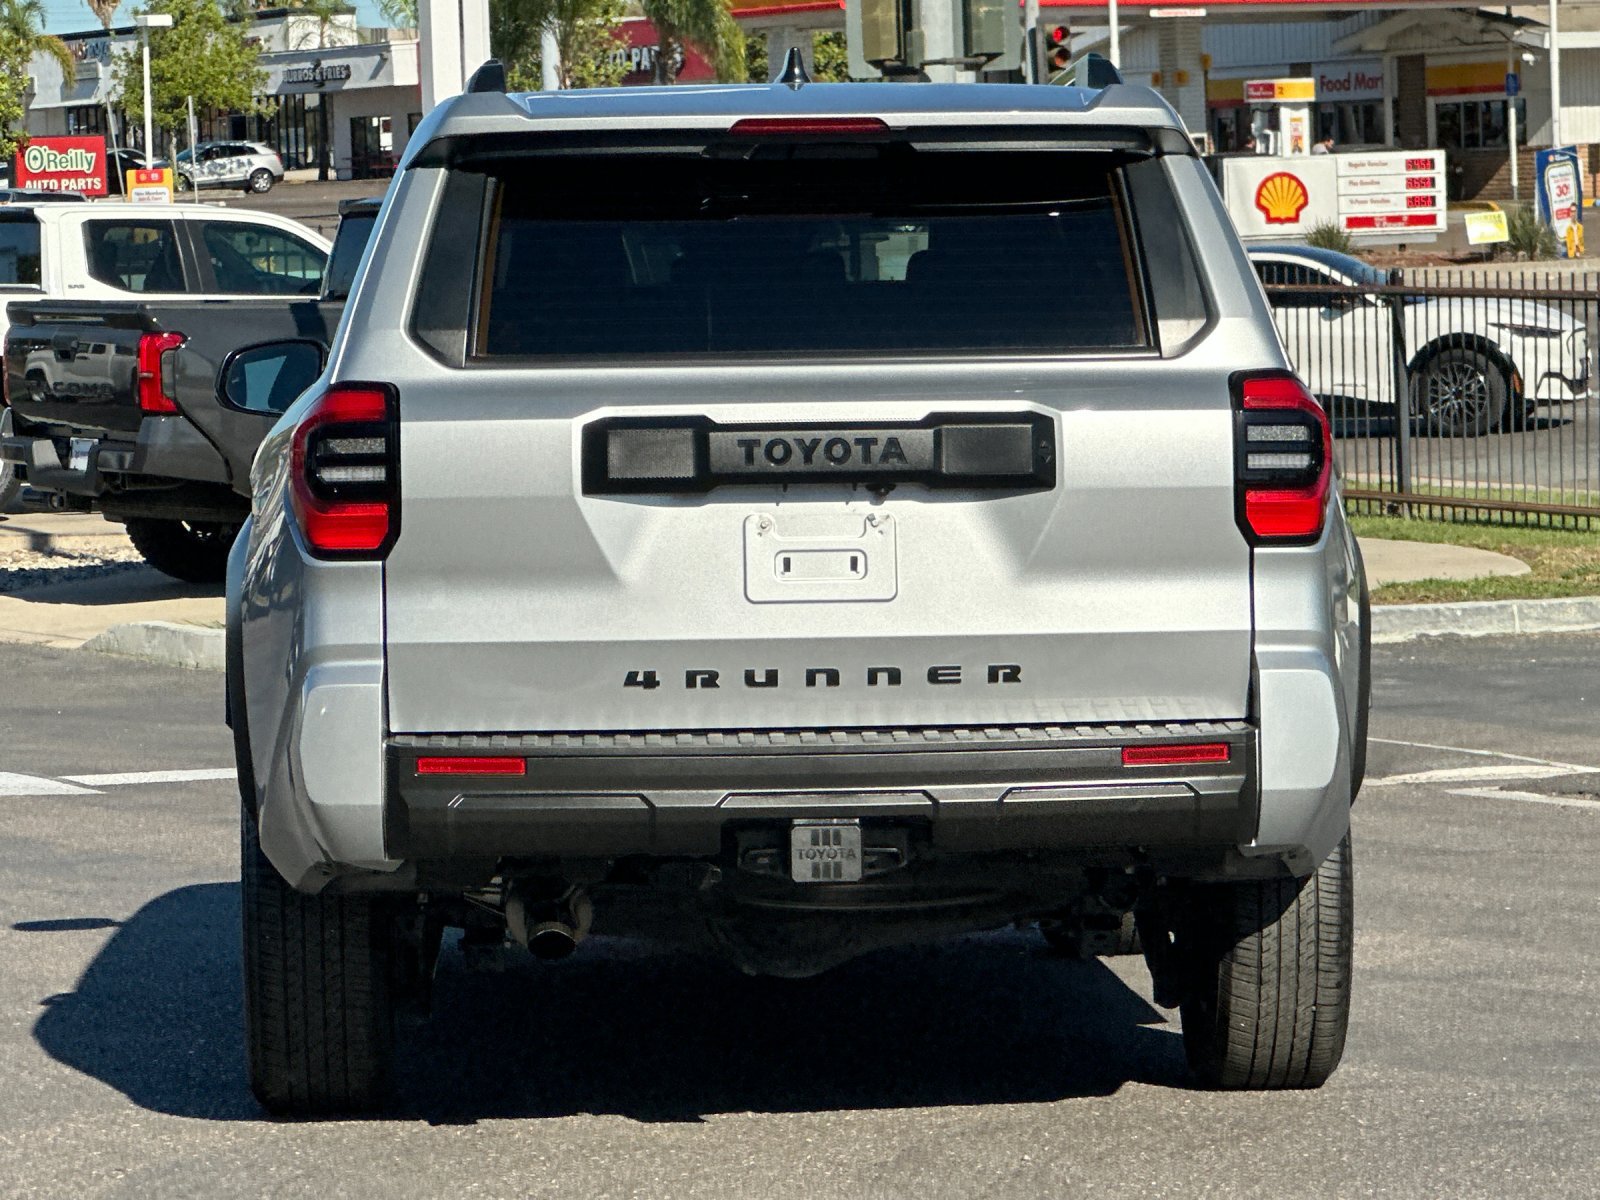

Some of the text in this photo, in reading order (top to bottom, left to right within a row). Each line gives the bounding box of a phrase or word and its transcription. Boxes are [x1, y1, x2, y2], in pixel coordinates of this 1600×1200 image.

[631, 45, 682, 71] PAS
[1320, 72, 1350, 93] Food
[27, 147, 94, 172] O'Reilly
[25, 178, 101, 190] AUTO PARTS
[25, 381, 113, 397] TCOMA
[737, 437, 908, 466] TOYOTA
[623, 665, 1022, 689] 4RUNNER
[796, 848, 857, 860] TOYOTA
